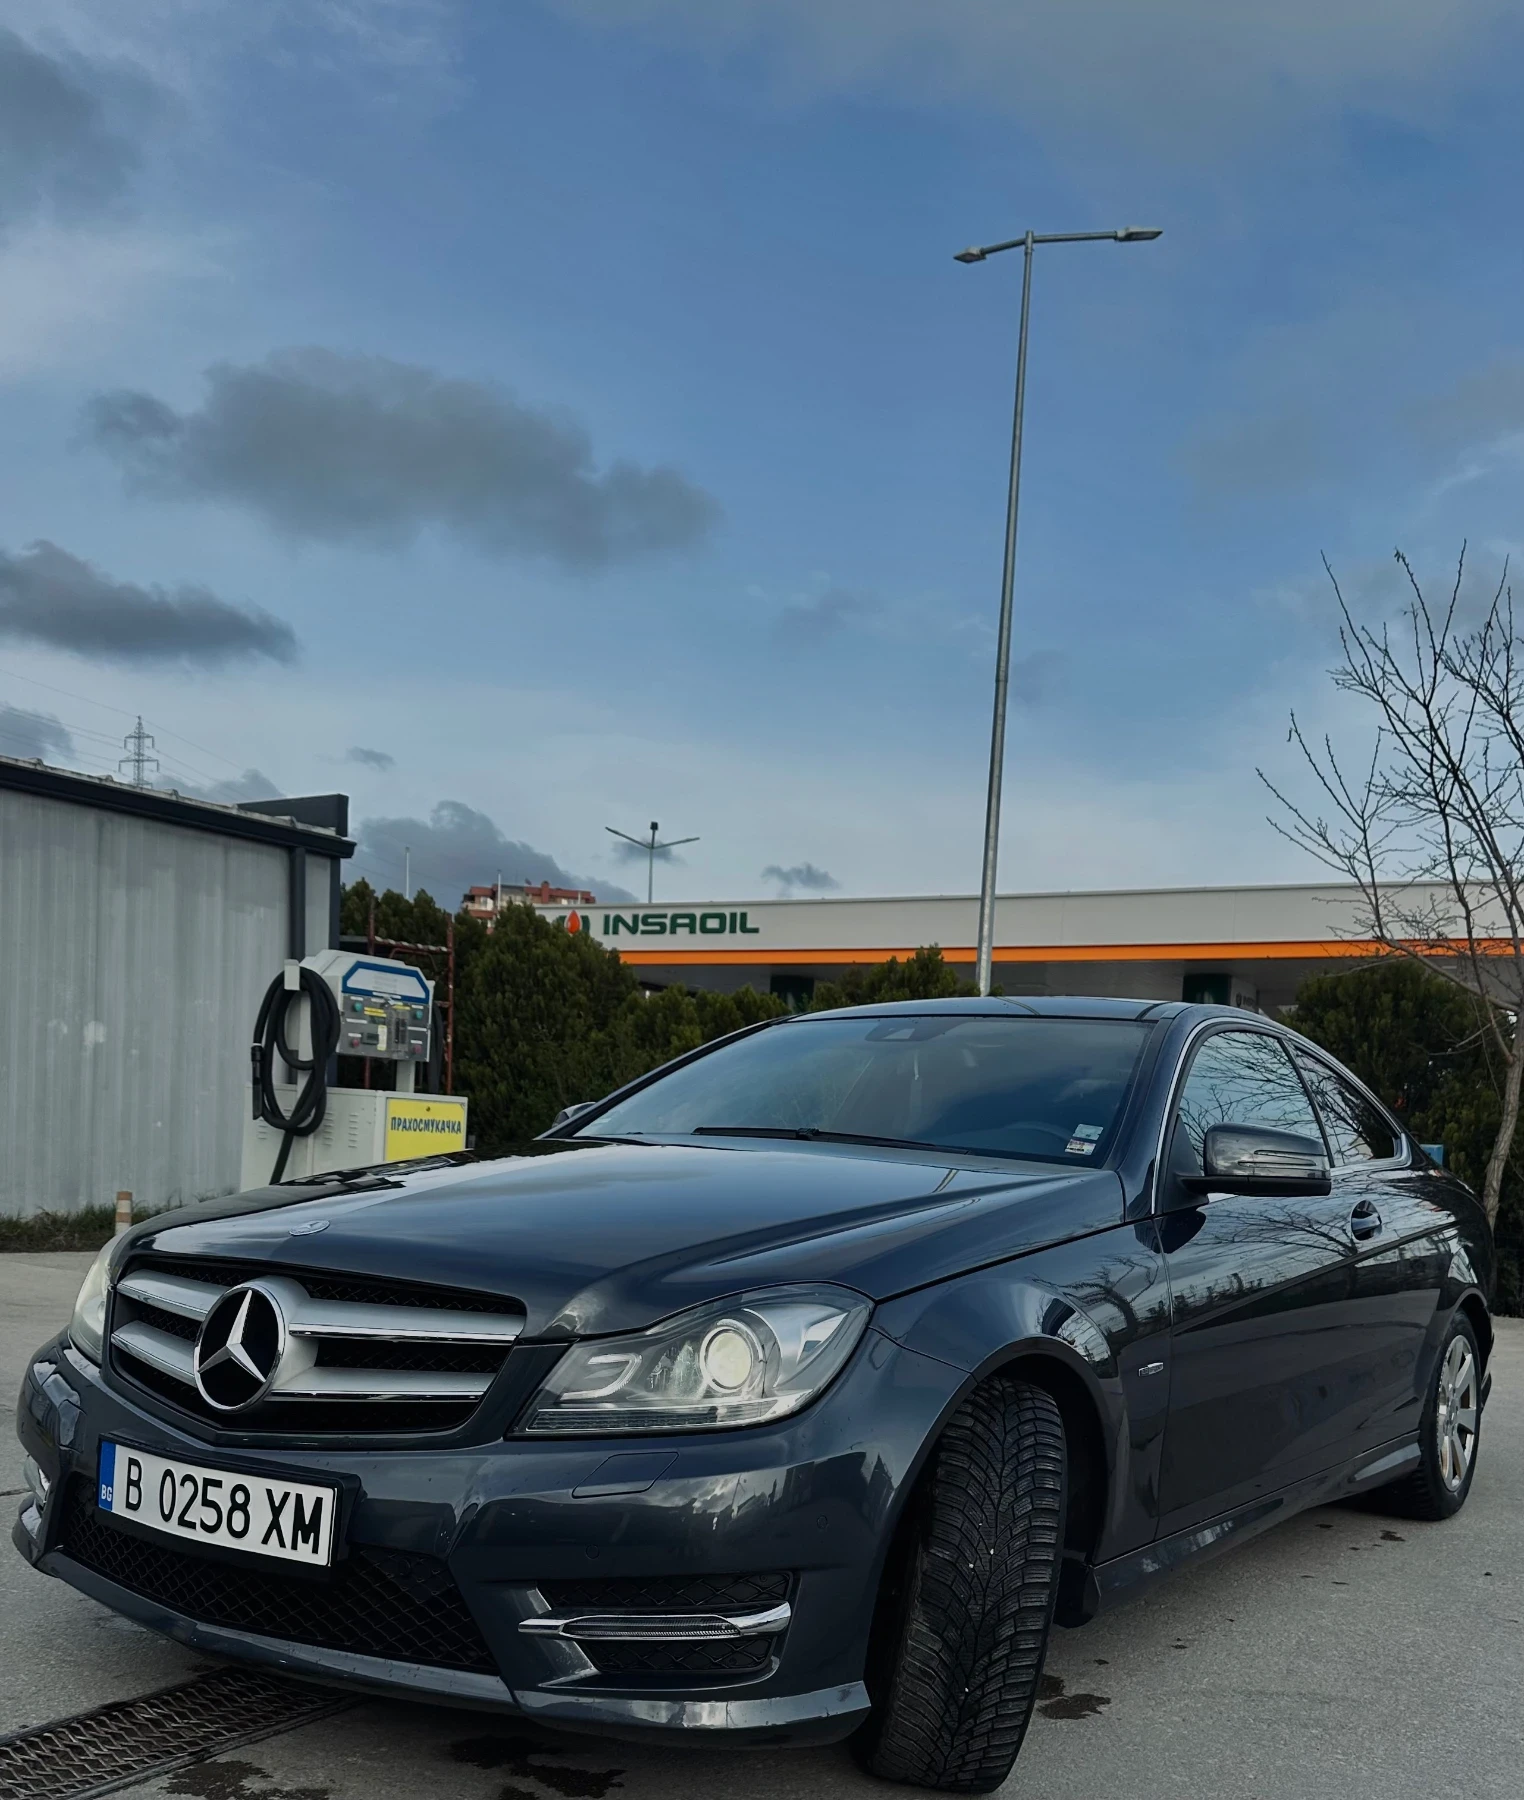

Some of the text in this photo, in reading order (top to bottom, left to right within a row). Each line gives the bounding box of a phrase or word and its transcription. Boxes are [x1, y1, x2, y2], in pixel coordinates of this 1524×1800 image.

[602, 912, 760, 935] INSAOIL
[391, 1117, 462, 1134] ПРАХОСМУКАЧКА
[101, 1484, 112, 1501] BG
[125, 1457, 324, 1554] B 0258 XM
